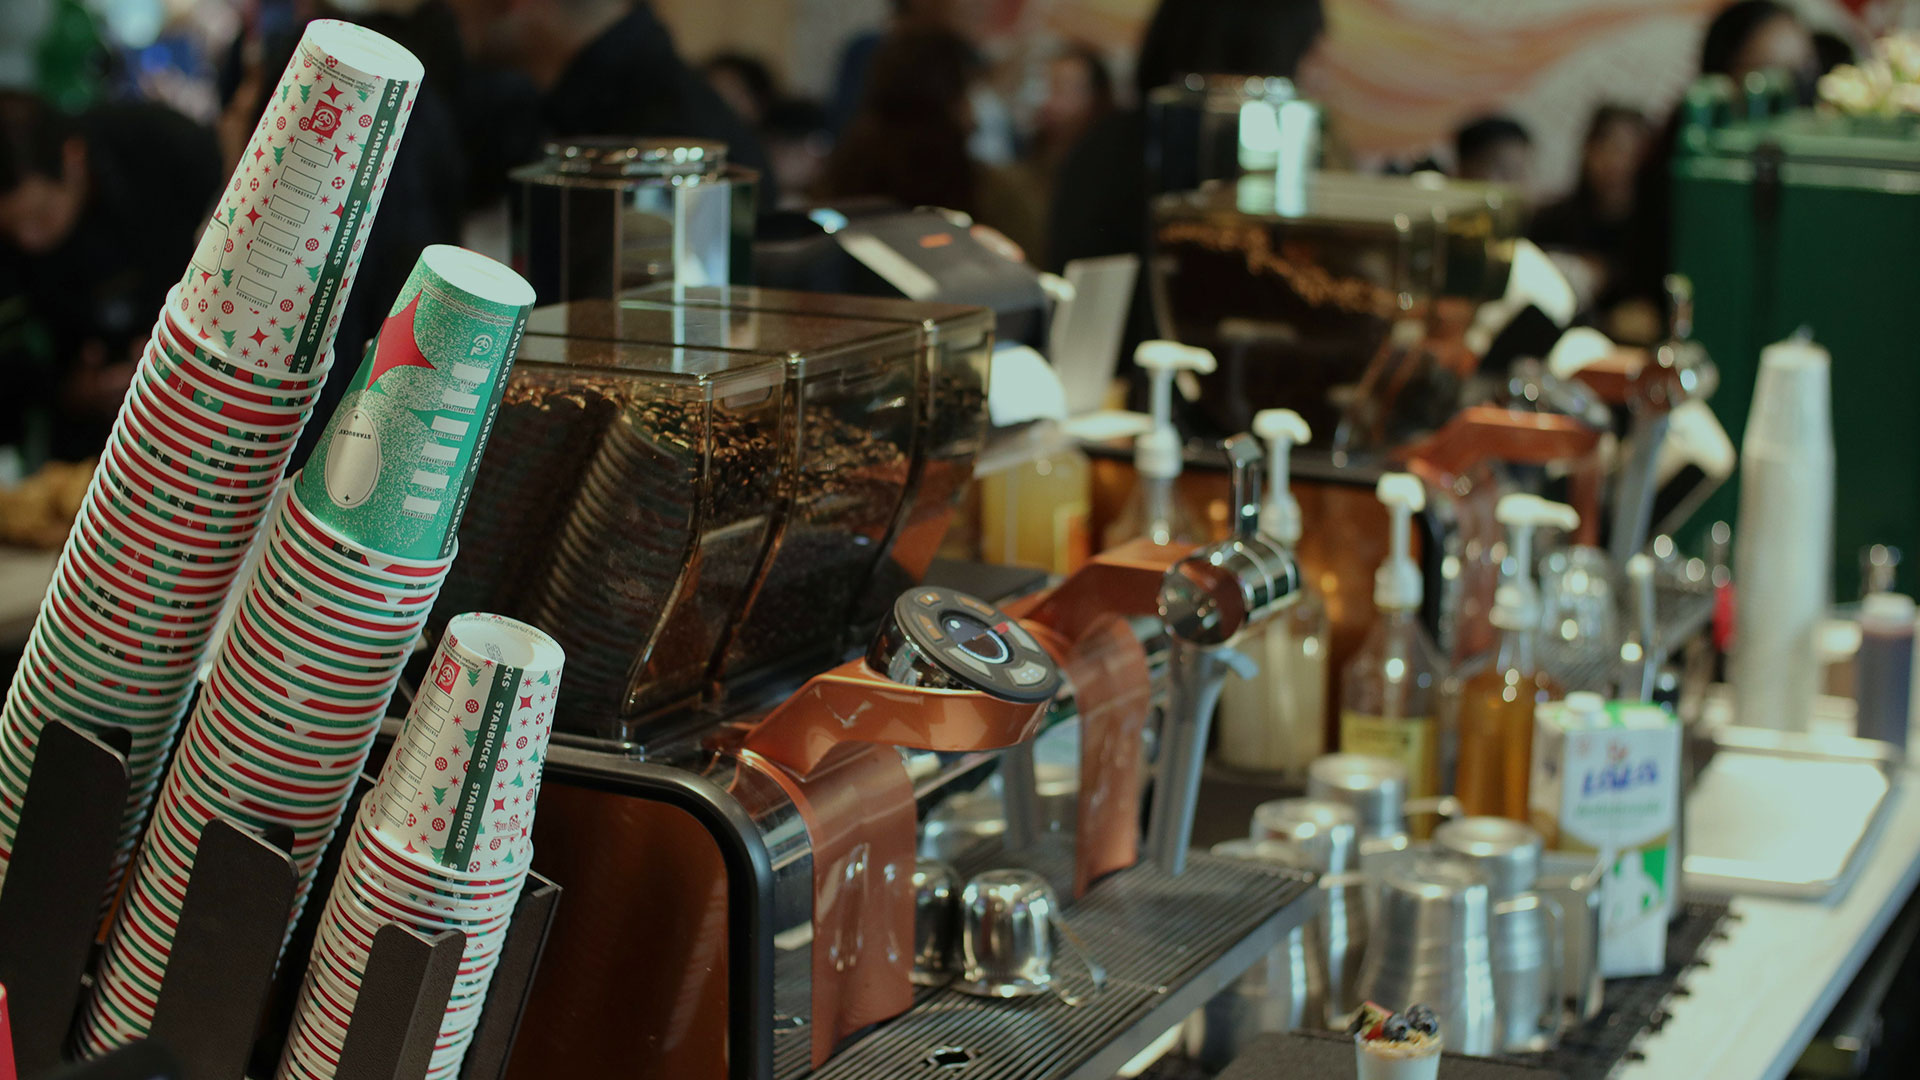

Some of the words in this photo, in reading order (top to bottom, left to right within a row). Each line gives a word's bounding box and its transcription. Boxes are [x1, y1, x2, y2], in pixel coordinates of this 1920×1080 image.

[361, 120, 389, 189] STARBUCKS
[333, 200, 361, 266] STARBUCKS
[307, 278, 334, 344] STARBUCKS
[499, 318, 525, 389] STARBUCKS
[339, 429, 371, 440] STARBUCKS
[471, 403, 498, 474] STARBUCKS
[444, 486, 470, 554] STARBUCKS
[479, 701, 504, 770] STARBUCKS
[456, 782, 481, 850] STARBUCKS
